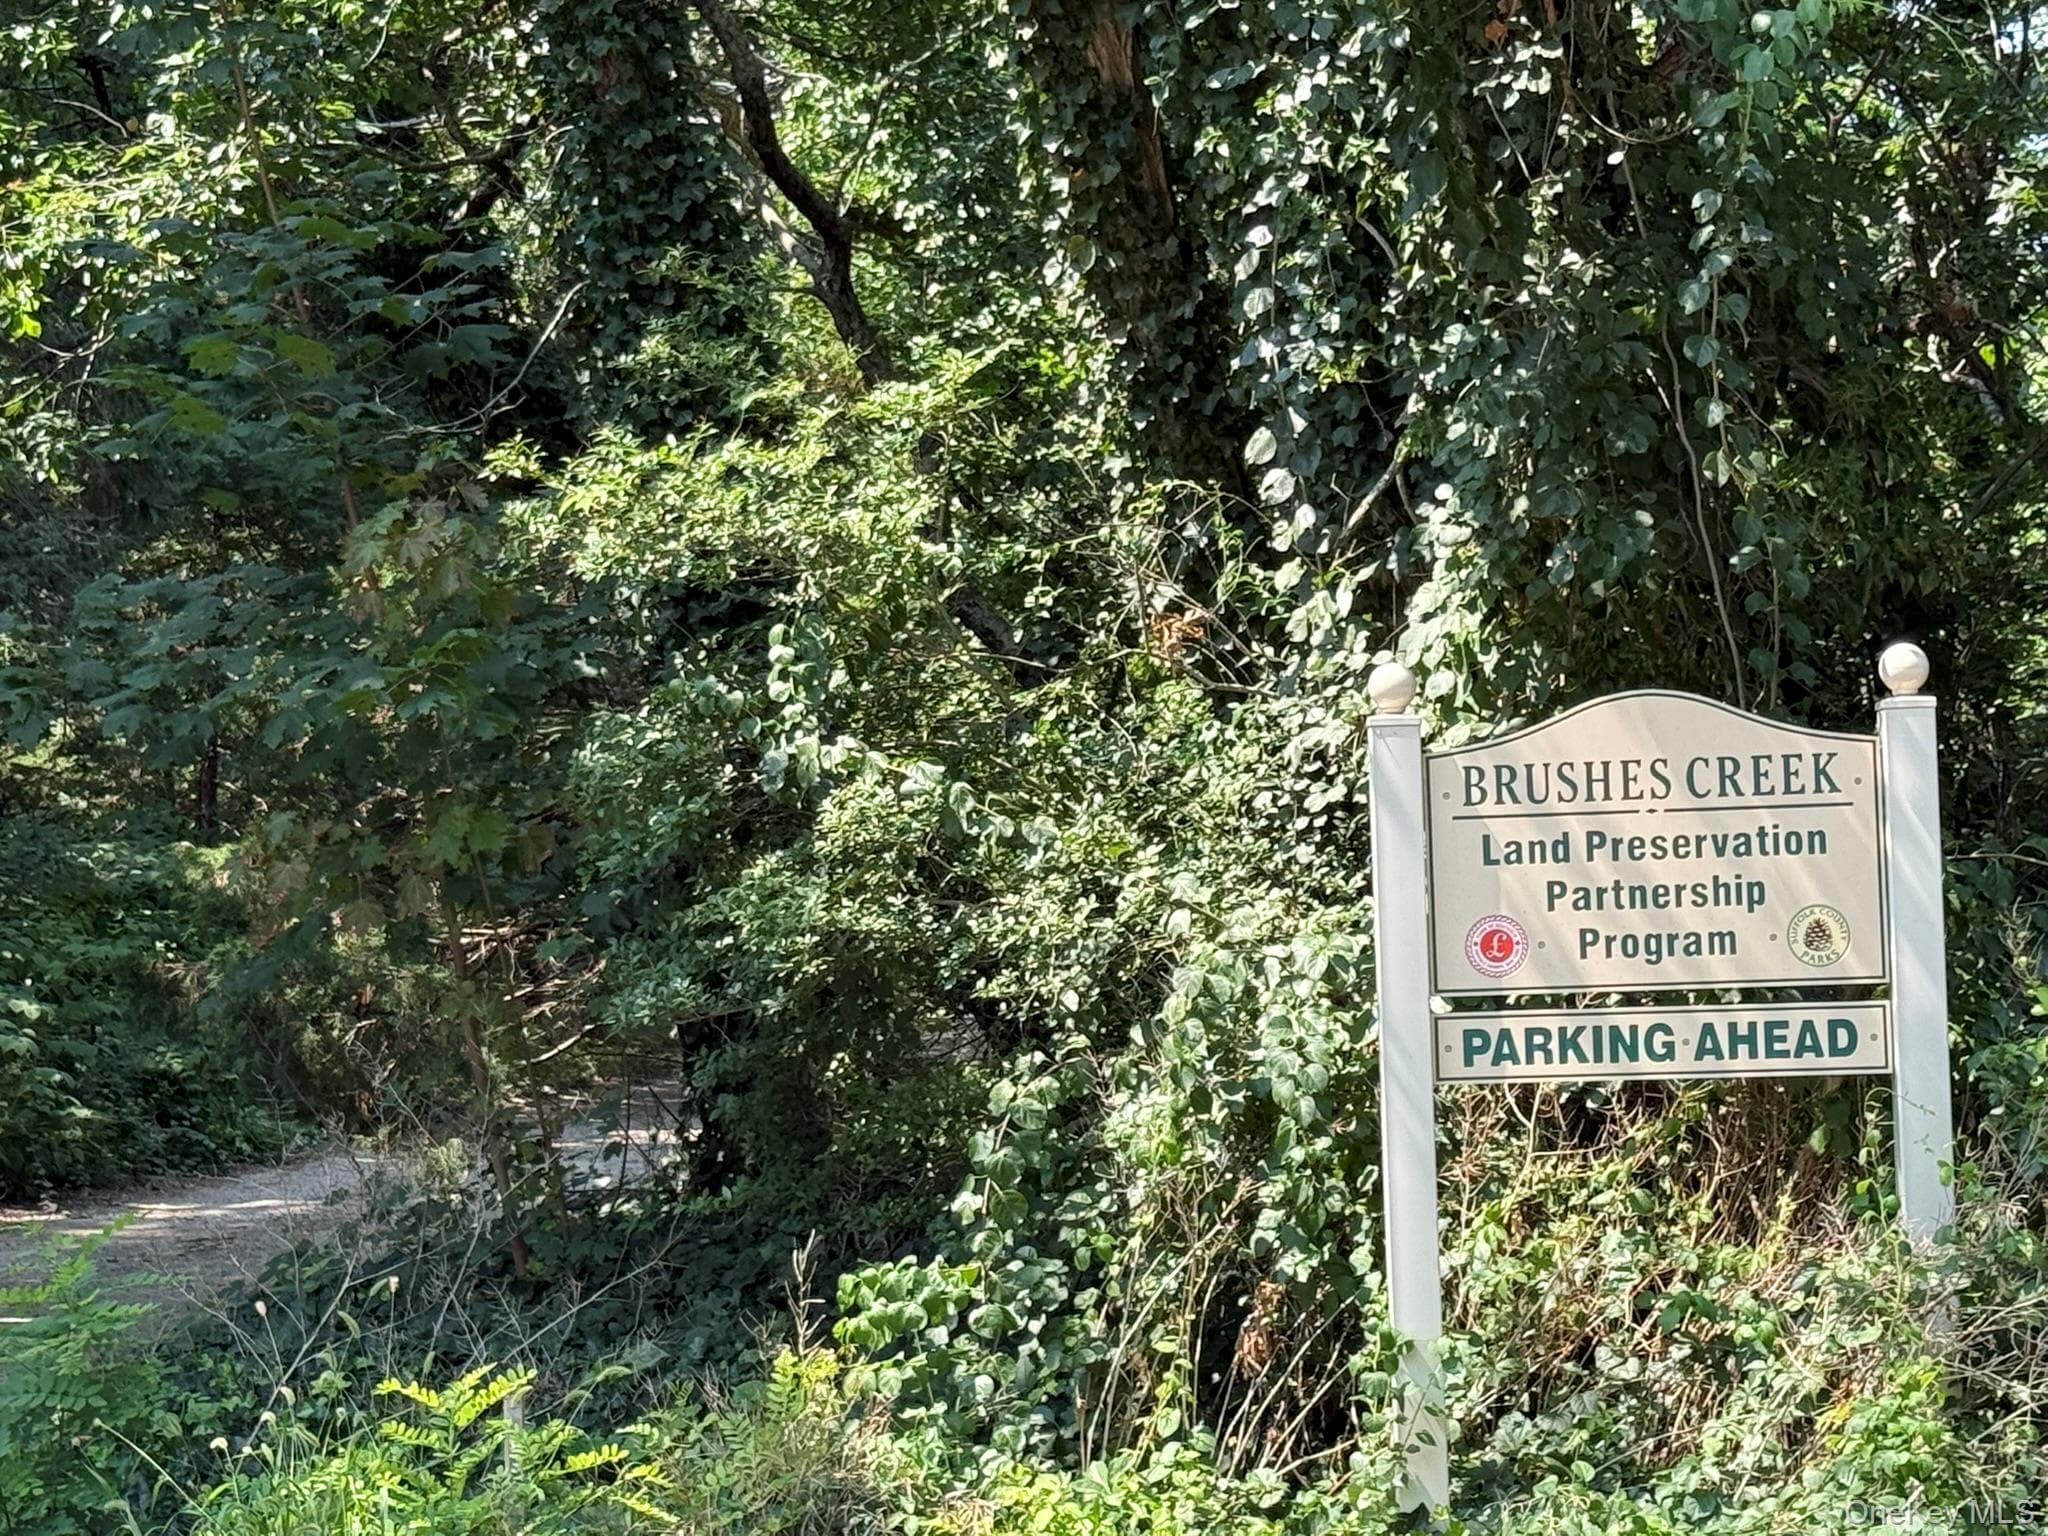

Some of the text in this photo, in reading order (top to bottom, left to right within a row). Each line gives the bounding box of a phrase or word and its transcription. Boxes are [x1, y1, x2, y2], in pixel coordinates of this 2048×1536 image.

[1462, 752, 1842, 806] BRUSHES CREEK
[1482, 825, 1828, 866] Land Preservation
[1546, 874, 1766, 913] Partnership
[1579, 928, 1737, 964] Program
[1800, 949, 1840, 964] PARKS
[1462, 1019, 1858, 1067] PARKING AHEAD
